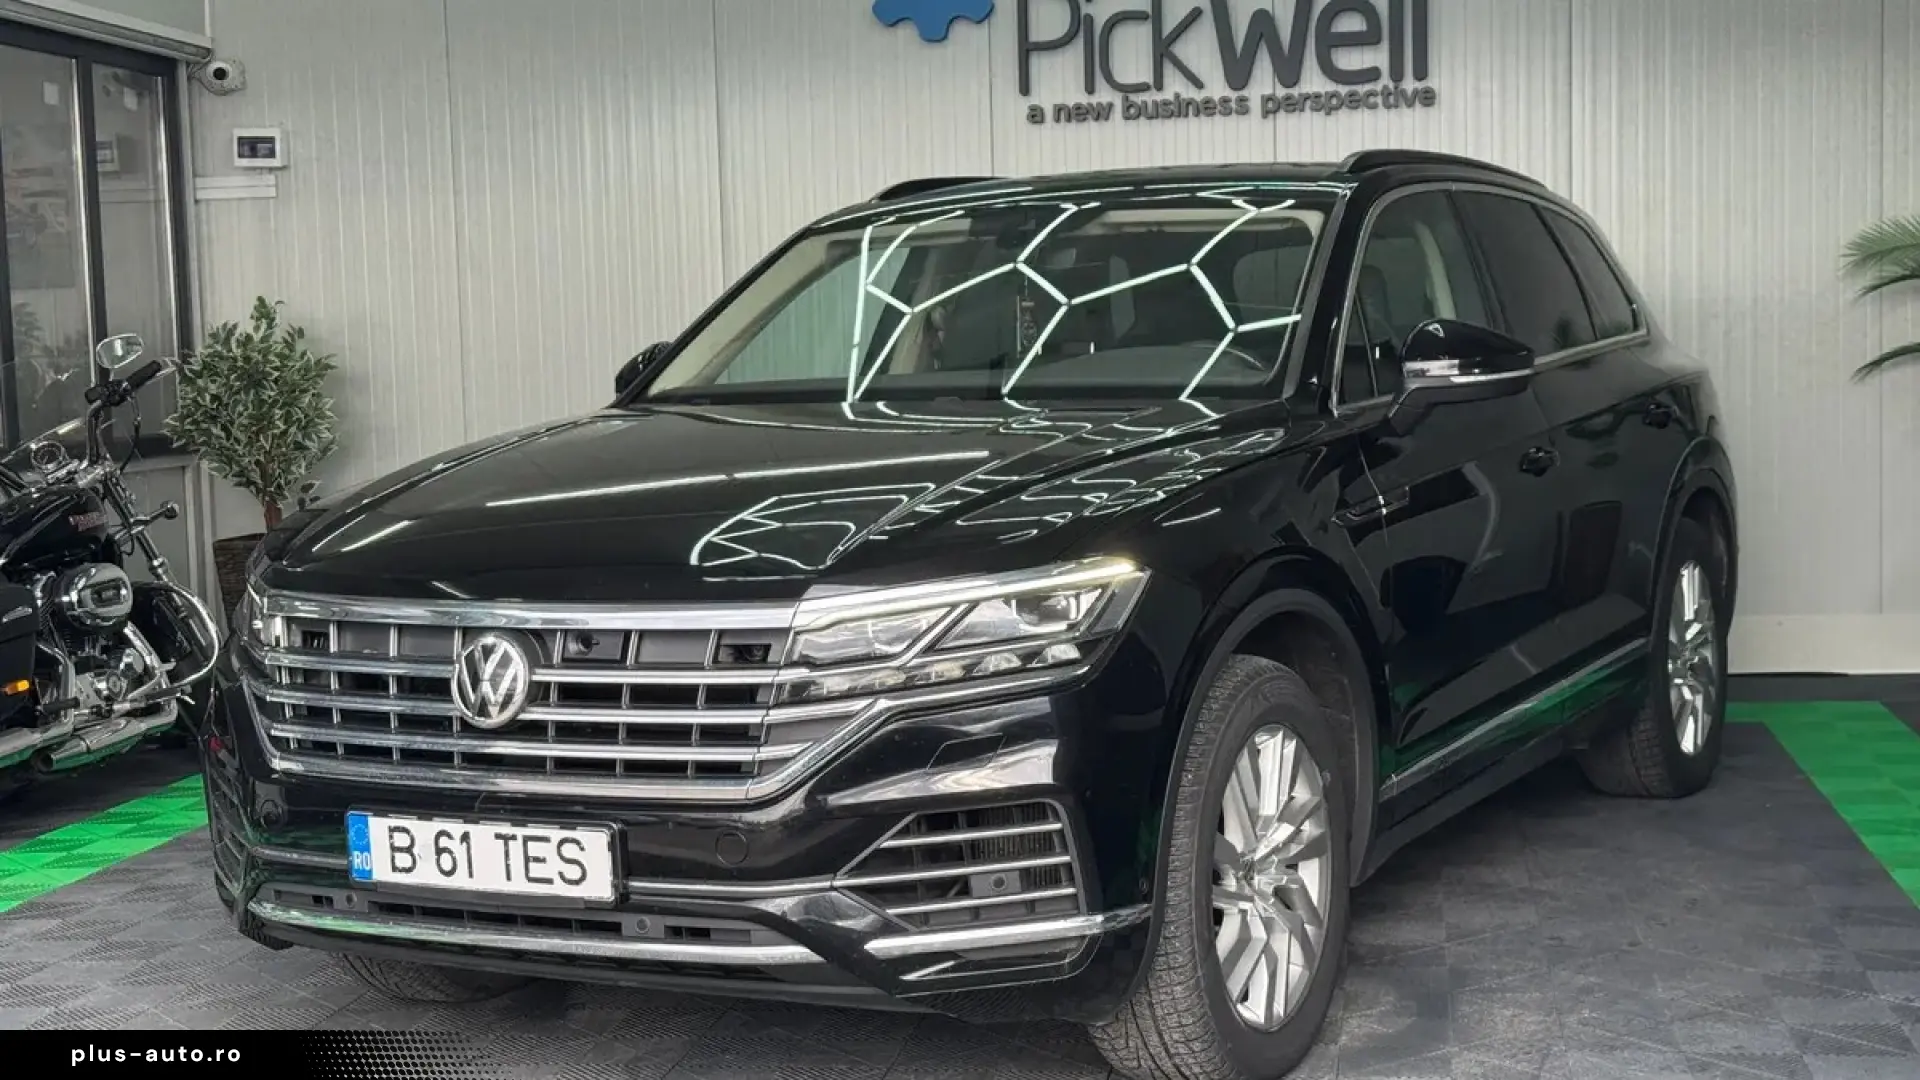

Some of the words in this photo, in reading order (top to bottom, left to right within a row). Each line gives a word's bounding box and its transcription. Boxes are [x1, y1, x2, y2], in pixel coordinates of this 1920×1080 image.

[1026, 103, 1045, 124] a
[1053, 101, 1114, 123] new
[1122, 93, 1249, 120] business
[1261, 84, 1436, 119] perspective
[354, 851, 371, 871] RO
[388, 825, 417, 874] B
[434, 829, 474, 879] 61
[494, 832, 588, 886] TES
